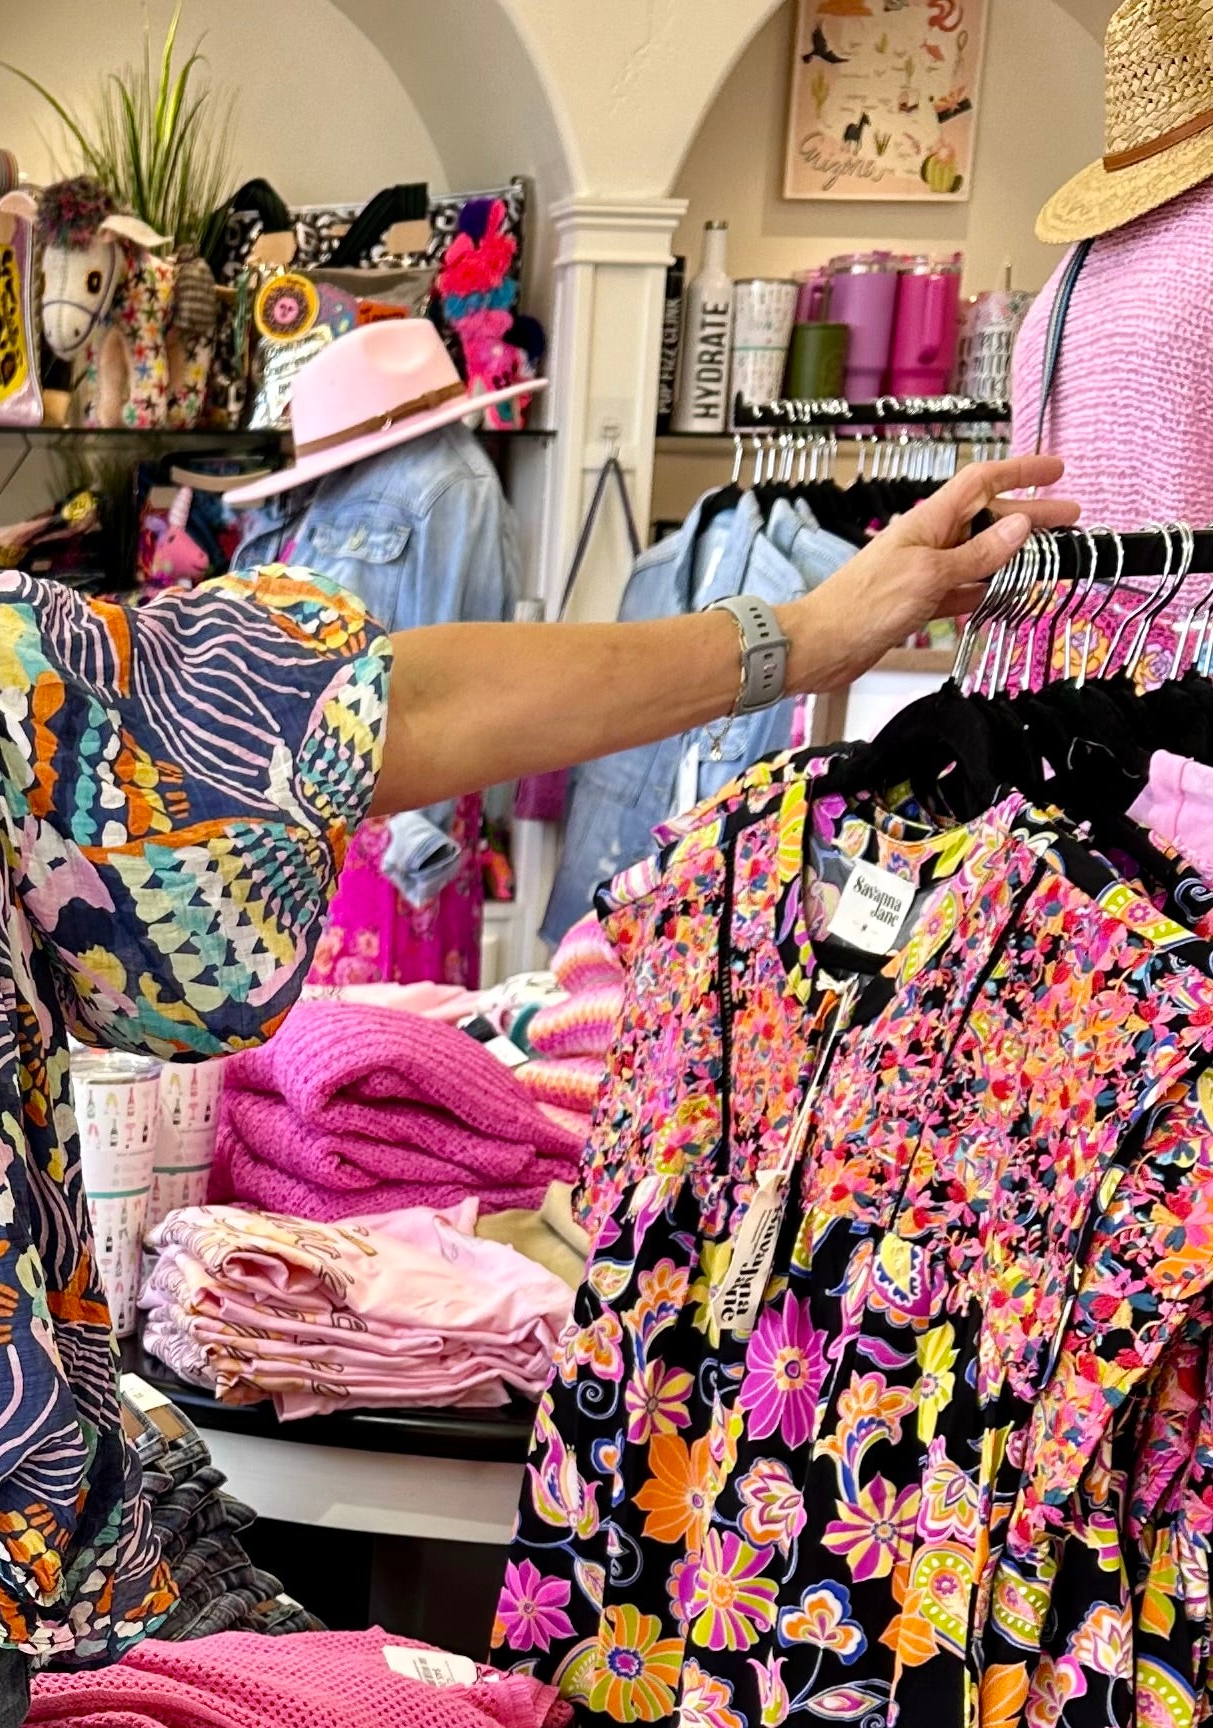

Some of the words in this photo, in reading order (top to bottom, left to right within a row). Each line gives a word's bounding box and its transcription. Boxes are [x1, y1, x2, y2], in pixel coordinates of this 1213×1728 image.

[693, 302, 729, 419] HYDRATE
[853, 875, 903, 913] Savanna
[870, 895, 900, 928] Jane
